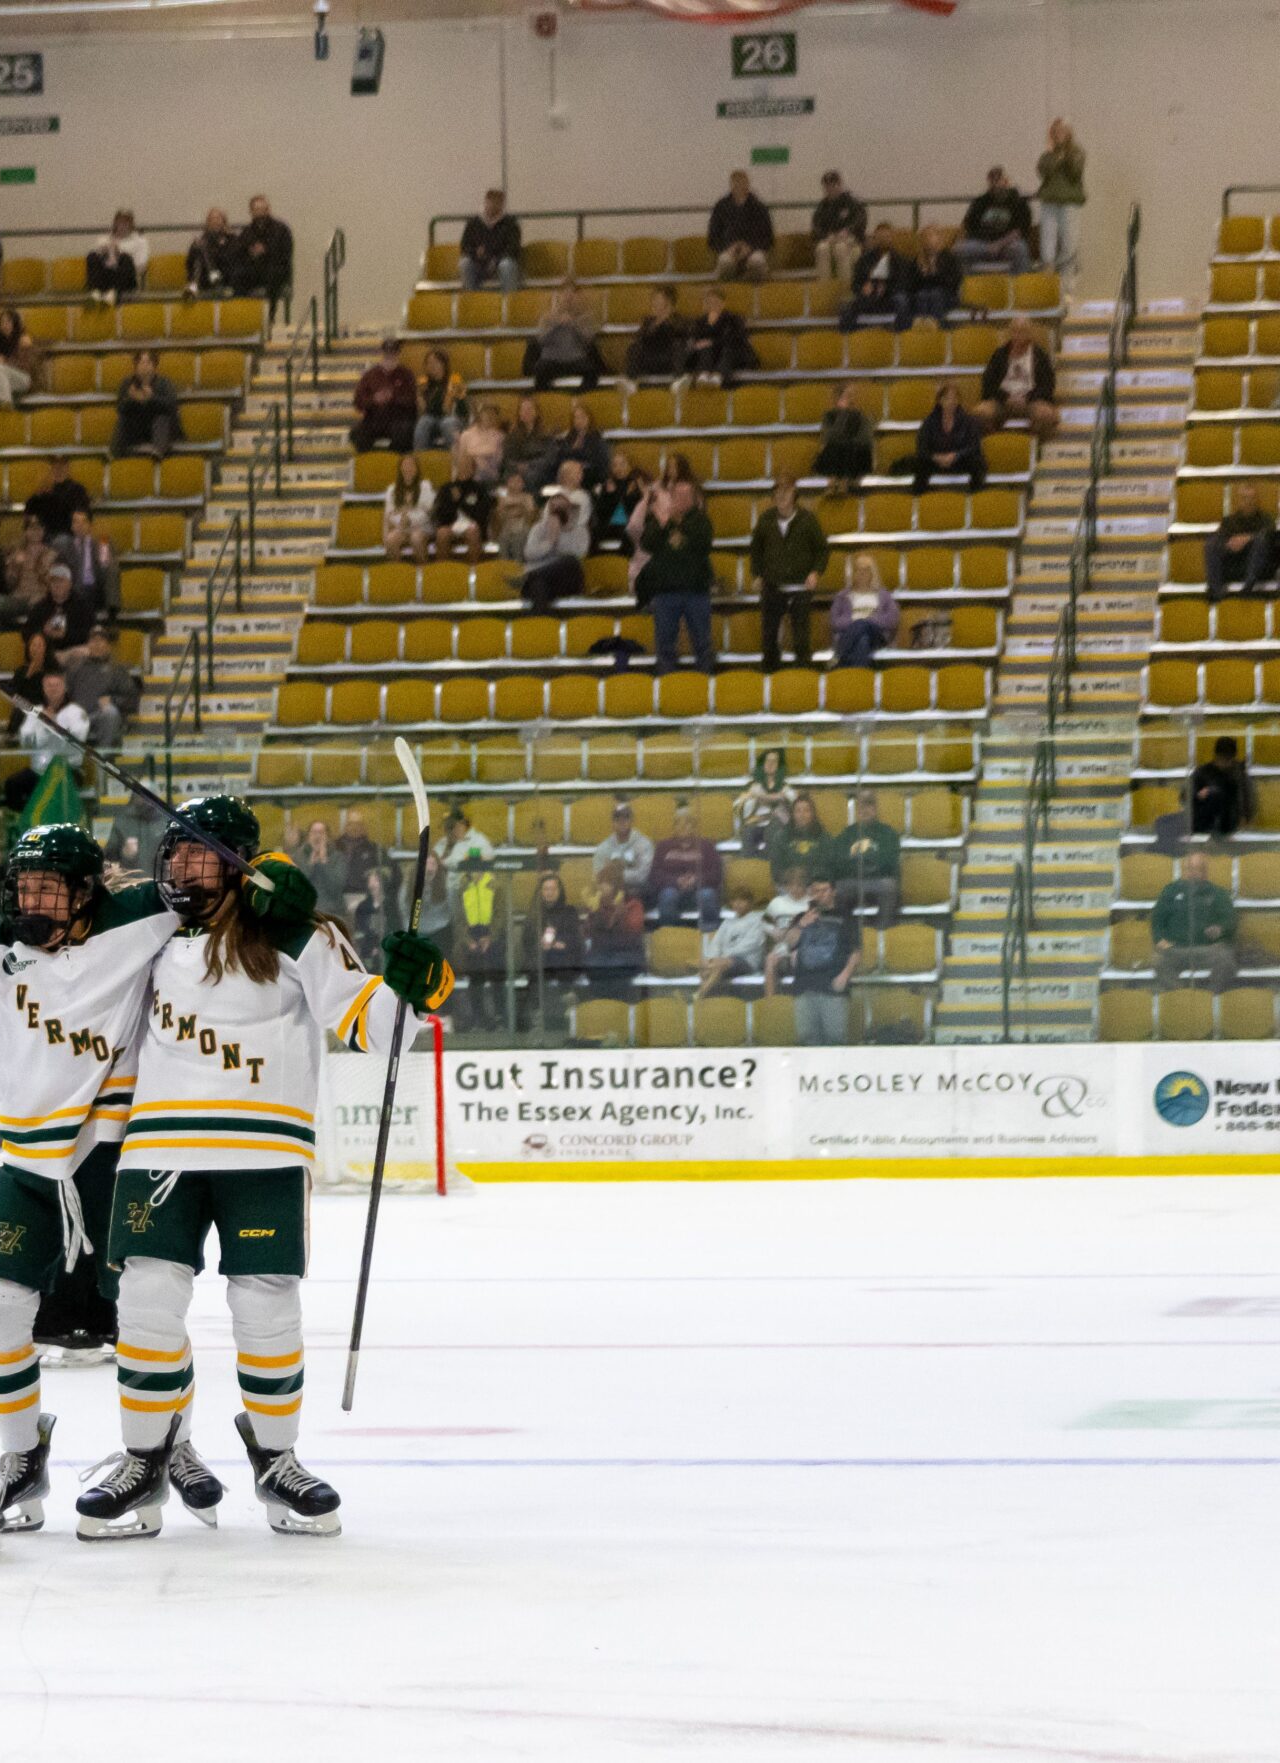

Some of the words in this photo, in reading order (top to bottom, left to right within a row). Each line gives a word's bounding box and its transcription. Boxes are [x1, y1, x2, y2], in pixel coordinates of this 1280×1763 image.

[741, 41, 787, 70] 26
[17, 850, 43, 858] CCM
[455, 1062, 523, 1091] Gut
[540, 1058, 757, 1090] Insurance?
[799, 1074, 924, 1093] McSOLEY
[938, 1072, 1033, 1092] McCOY
[1215, 1079, 1270, 1095] New
[459, 1101, 509, 1122] The
[518, 1101, 593, 1122] Essex
[600, 1101, 707, 1127] Agency,
[559, 1133, 637, 1146] CONCORD
[640, 1133, 694, 1146] GROUP
[809, 1134, 858, 1145] Certified
[862, 1134, 896, 1145] Public
[900, 1134, 968, 1145] Accountants
[972, 1134, 994, 1144] and
[998, 1134, 1045, 1144] Business
[1049, 1134, 1098, 1144] Advisors
[239, 1229, 276, 1238] CCM
